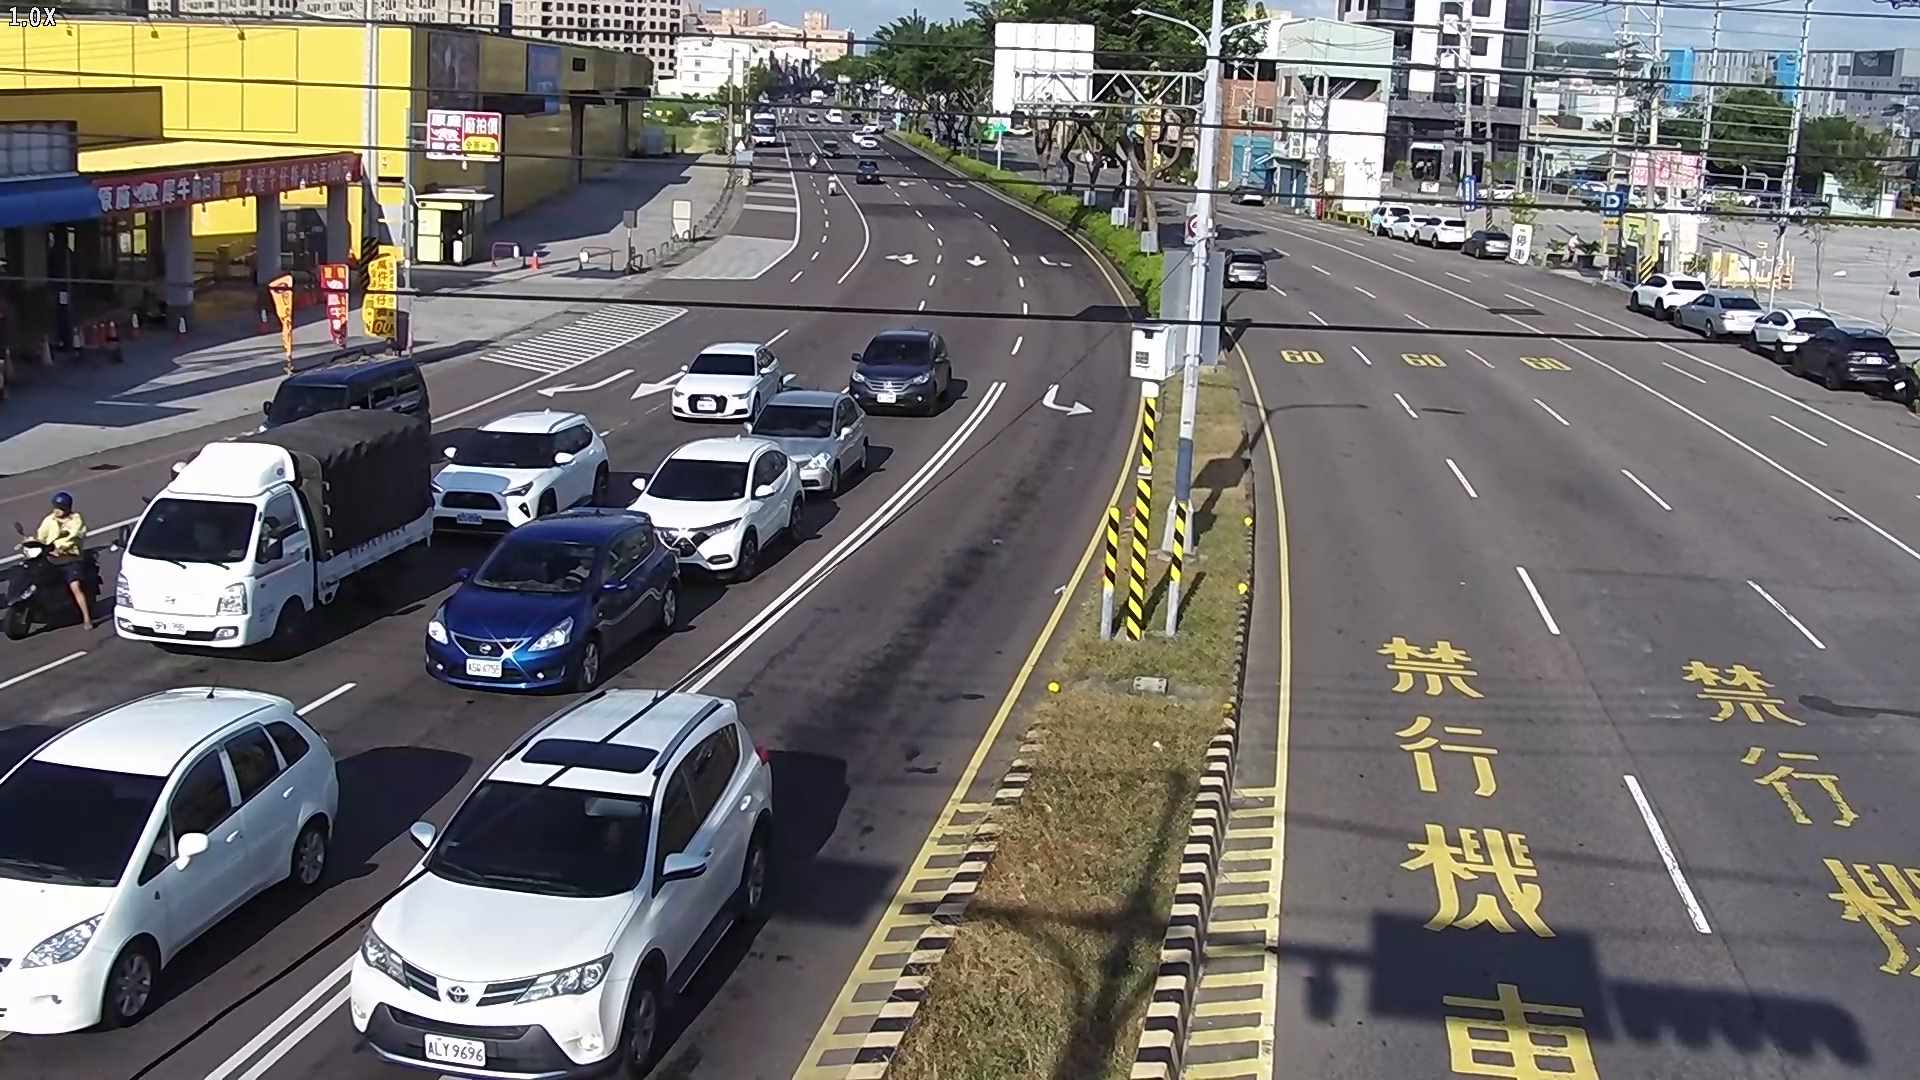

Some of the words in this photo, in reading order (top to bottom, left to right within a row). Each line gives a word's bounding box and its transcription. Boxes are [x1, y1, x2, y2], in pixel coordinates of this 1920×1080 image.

[1280, 350, 1325, 364] 60
[1401, 353, 1448, 367] 60
[1520, 357, 1572, 371] 60
